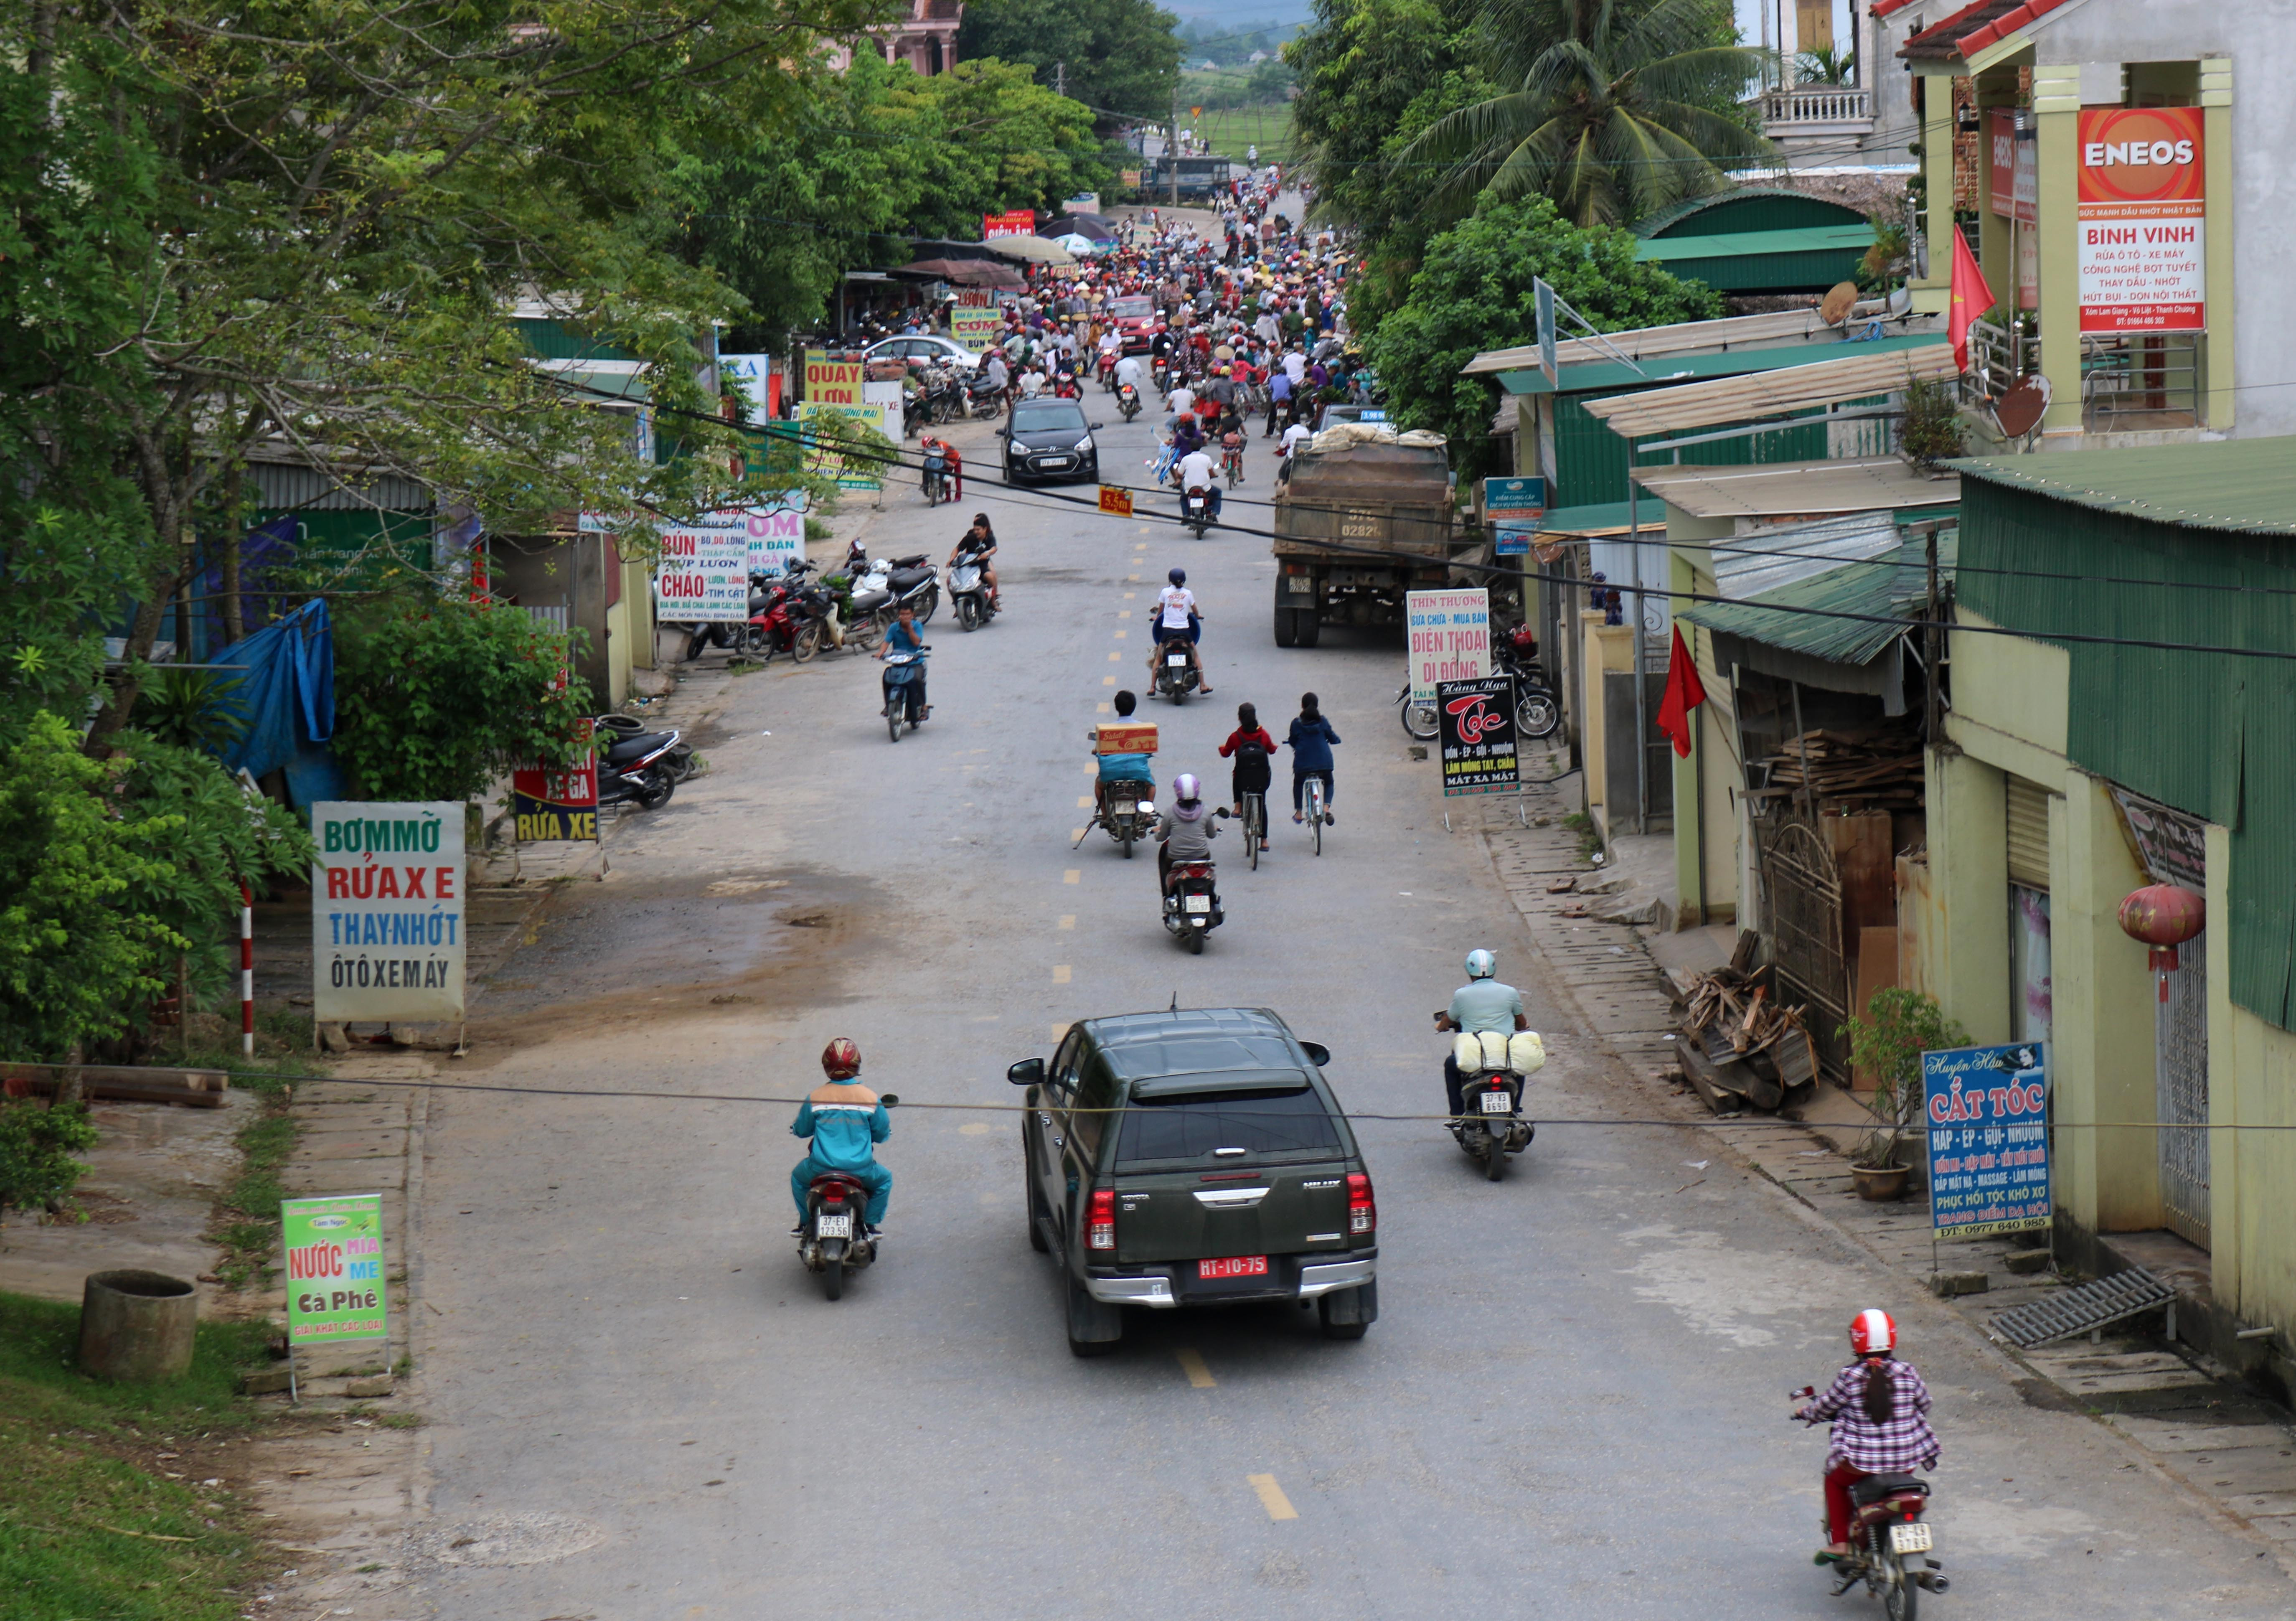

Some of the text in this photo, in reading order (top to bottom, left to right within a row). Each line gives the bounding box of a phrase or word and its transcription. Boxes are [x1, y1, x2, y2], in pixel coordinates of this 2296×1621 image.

[1994, 135, 2012, 169] ENEOS
[2085, 139, 2194, 167] ENEOS
[2144, 226, 2194, 243] VINH
[2164, 248, 2184, 258] MÁY
[2083, 264, 2111, 274] CÔNG
[2114, 263, 2141, 275] NGHỆ
[2166, 260, 2197, 272] TUYẾT
[2099, 279, 2123, 287] THAY
[2155, 276, 2181, 285] NHỚT
[2083, 287, 2197, 302] HÚT BỤI DỌN NỘI THẤT
[808, 365, 861, 384] QUAY
[661, 530, 695, 556] BÚN
[699, 558, 739, 568] LƯƠN
[662, 570, 704, 598] CHÁO
[1440, 594, 1486, 607] THƯƠNG
[1453, 613, 1470, 625] MUA
[1472, 610, 1487, 624] BÁN
[1412, 627, 1487, 657] ĐIỆN THOẠI
[1423, 662, 1436, 683] DI
[1481, 680, 1508, 691] Nga
[1446, 694, 1508, 744] Tóc
[1463, 744, 1471, 758] ÉP
[1462, 758, 1481, 773] MÓNG
[569, 774, 590, 799] GA
[1447, 775, 1471, 785] MÁT
[1473, 775, 1490, 783] XA
[517, 802, 597, 841] RỬA XE
[1929, 1076, 2044, 1123] CẮT TÓC
[1950, 1157, 1960, 1173] MI
[1978, 1171, 2008, 1187] MASSAGE
[2027, 1166, 2047, 1181] MÓNG
[1937, 1194, 1963, 1210] PHỤC
[1986, 1189, 2006, 1203] TÓC
[2008, 1185, 2029, 1202] KHÔ
[823, 1217, 844, 1226] 37-E1
[1936, 1209, 1976, 1226] TRANG
[2008, 1205, 2025, 1220] DẠ
[2027, 1200, 2048, 1218] HỘI
[821, 1226, 847, 1235] 123.56
[1940, 1218, 2046, 1237] ĐT: 0977 640 985
[288, 1236, 381, 1281] NƯỚC MÍA
[349, 1261, 380, 1280] ME
[1152, 1284, 1162, 1295] CT
[298, 1288, 378, 1313] Cà Phê
[315, 1321, 338, 1334] KHÁT
[341, 1319, 360, 1332] CÁC
[363, 1319, 383, 1333] LOẠI
